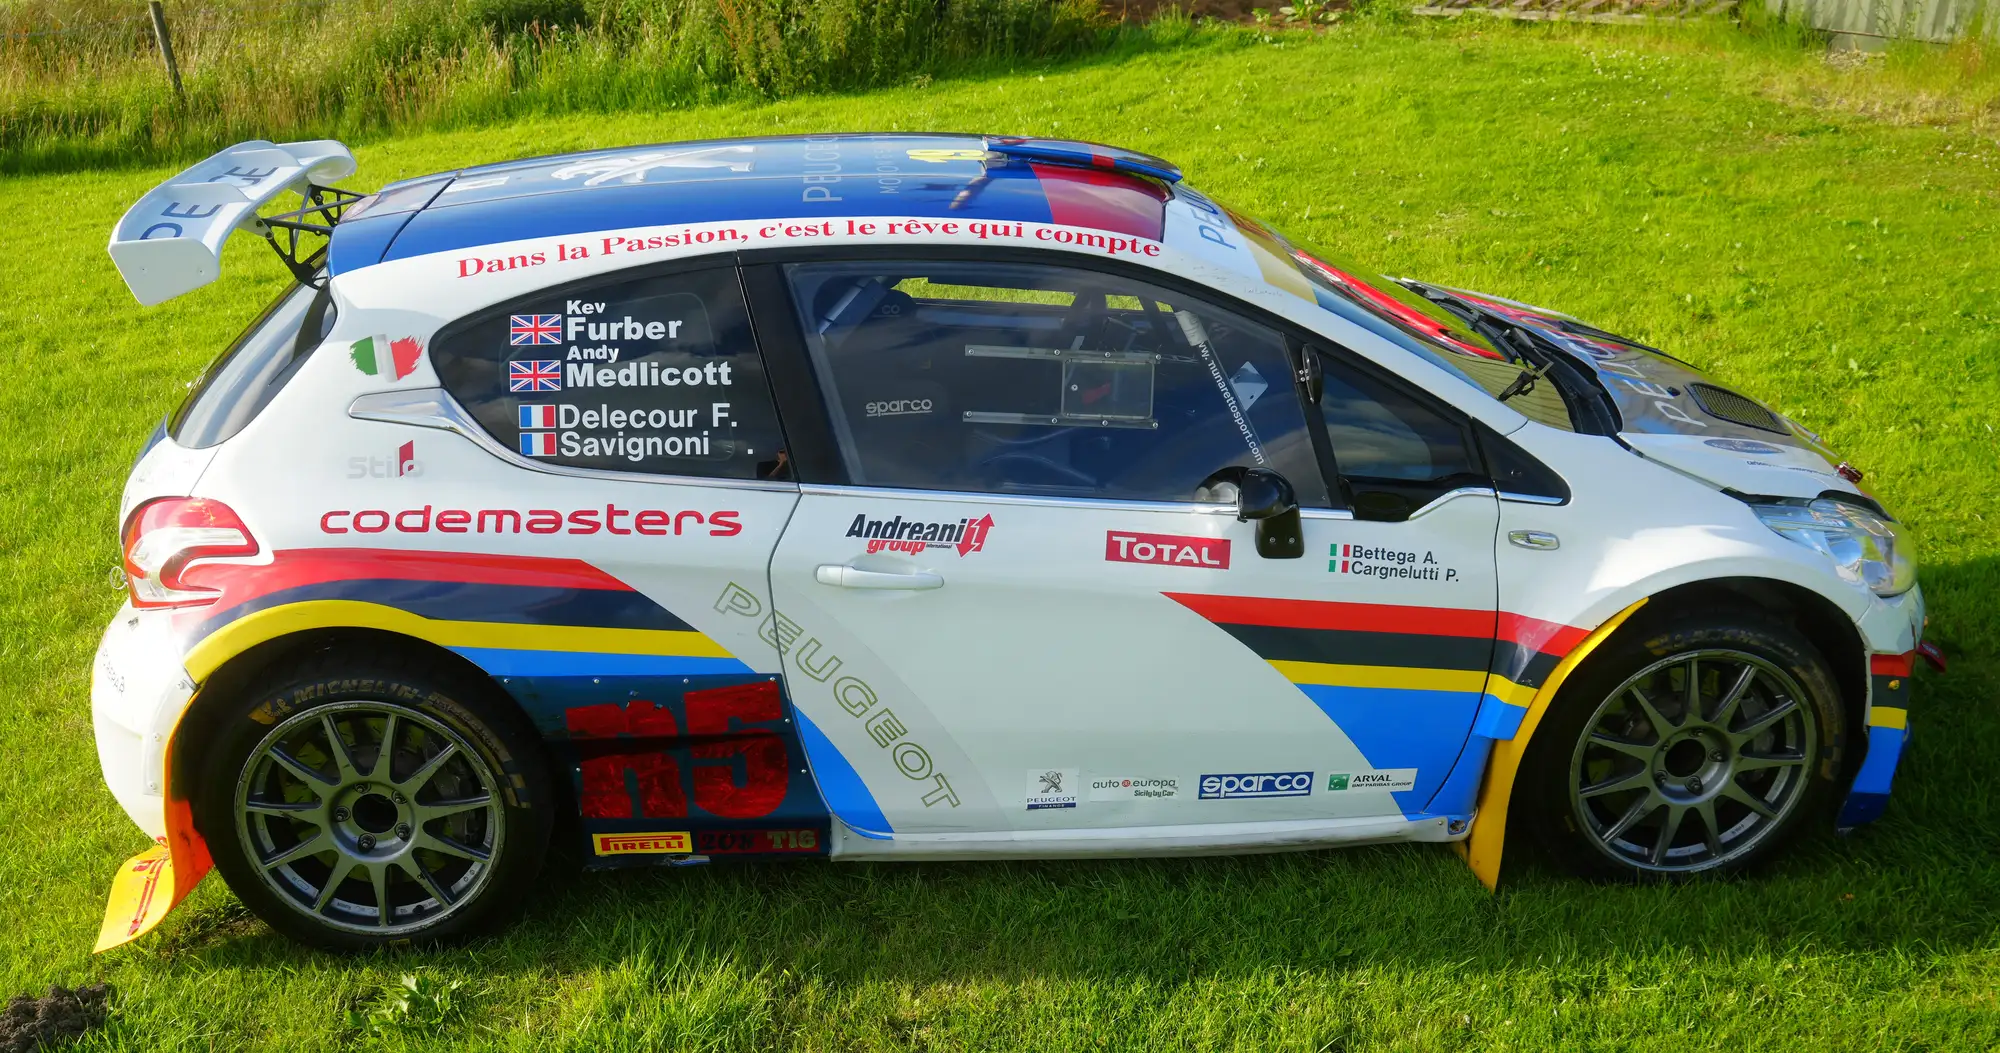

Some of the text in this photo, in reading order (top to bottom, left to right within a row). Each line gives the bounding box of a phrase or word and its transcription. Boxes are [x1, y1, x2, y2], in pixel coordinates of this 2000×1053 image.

[456, 219, 1160, 279] Dans la Passion, c'est le rêve qui compte
[566, 299, 606, 315] Kev
[566, 315, 683, 341] Furber
[566, 344, 620, 364] Andy
[566, 360, 733, 389] Medlicott
[558, 402, 738, 429] Delecour F.
[866, 398, 933, 417] sparco
[560, 430, 710, 462] Savignoni
[320, 503, 743, 538] codemasters
[845, 513, 968, 543] Andreani
[866, 540, 927, 556] group
[1112, 535, 1220, 565] TOTAL
[1352, 544, 1438, 565] Bettega A.
[1351, 560, 1460, 582] Cargnelutti P.
[713, 581, 962, 808] PEUGEOT
[565, 681, 789, 820] R5
[1092, 779, 1120, 789] auto
[1202, 773, 1311, 799] sparco
[1353, 774, 1392, 783] ARVAL
[1162, 789, 1175, 798] Car
[600, 834, 685, 852] PIRELLI
